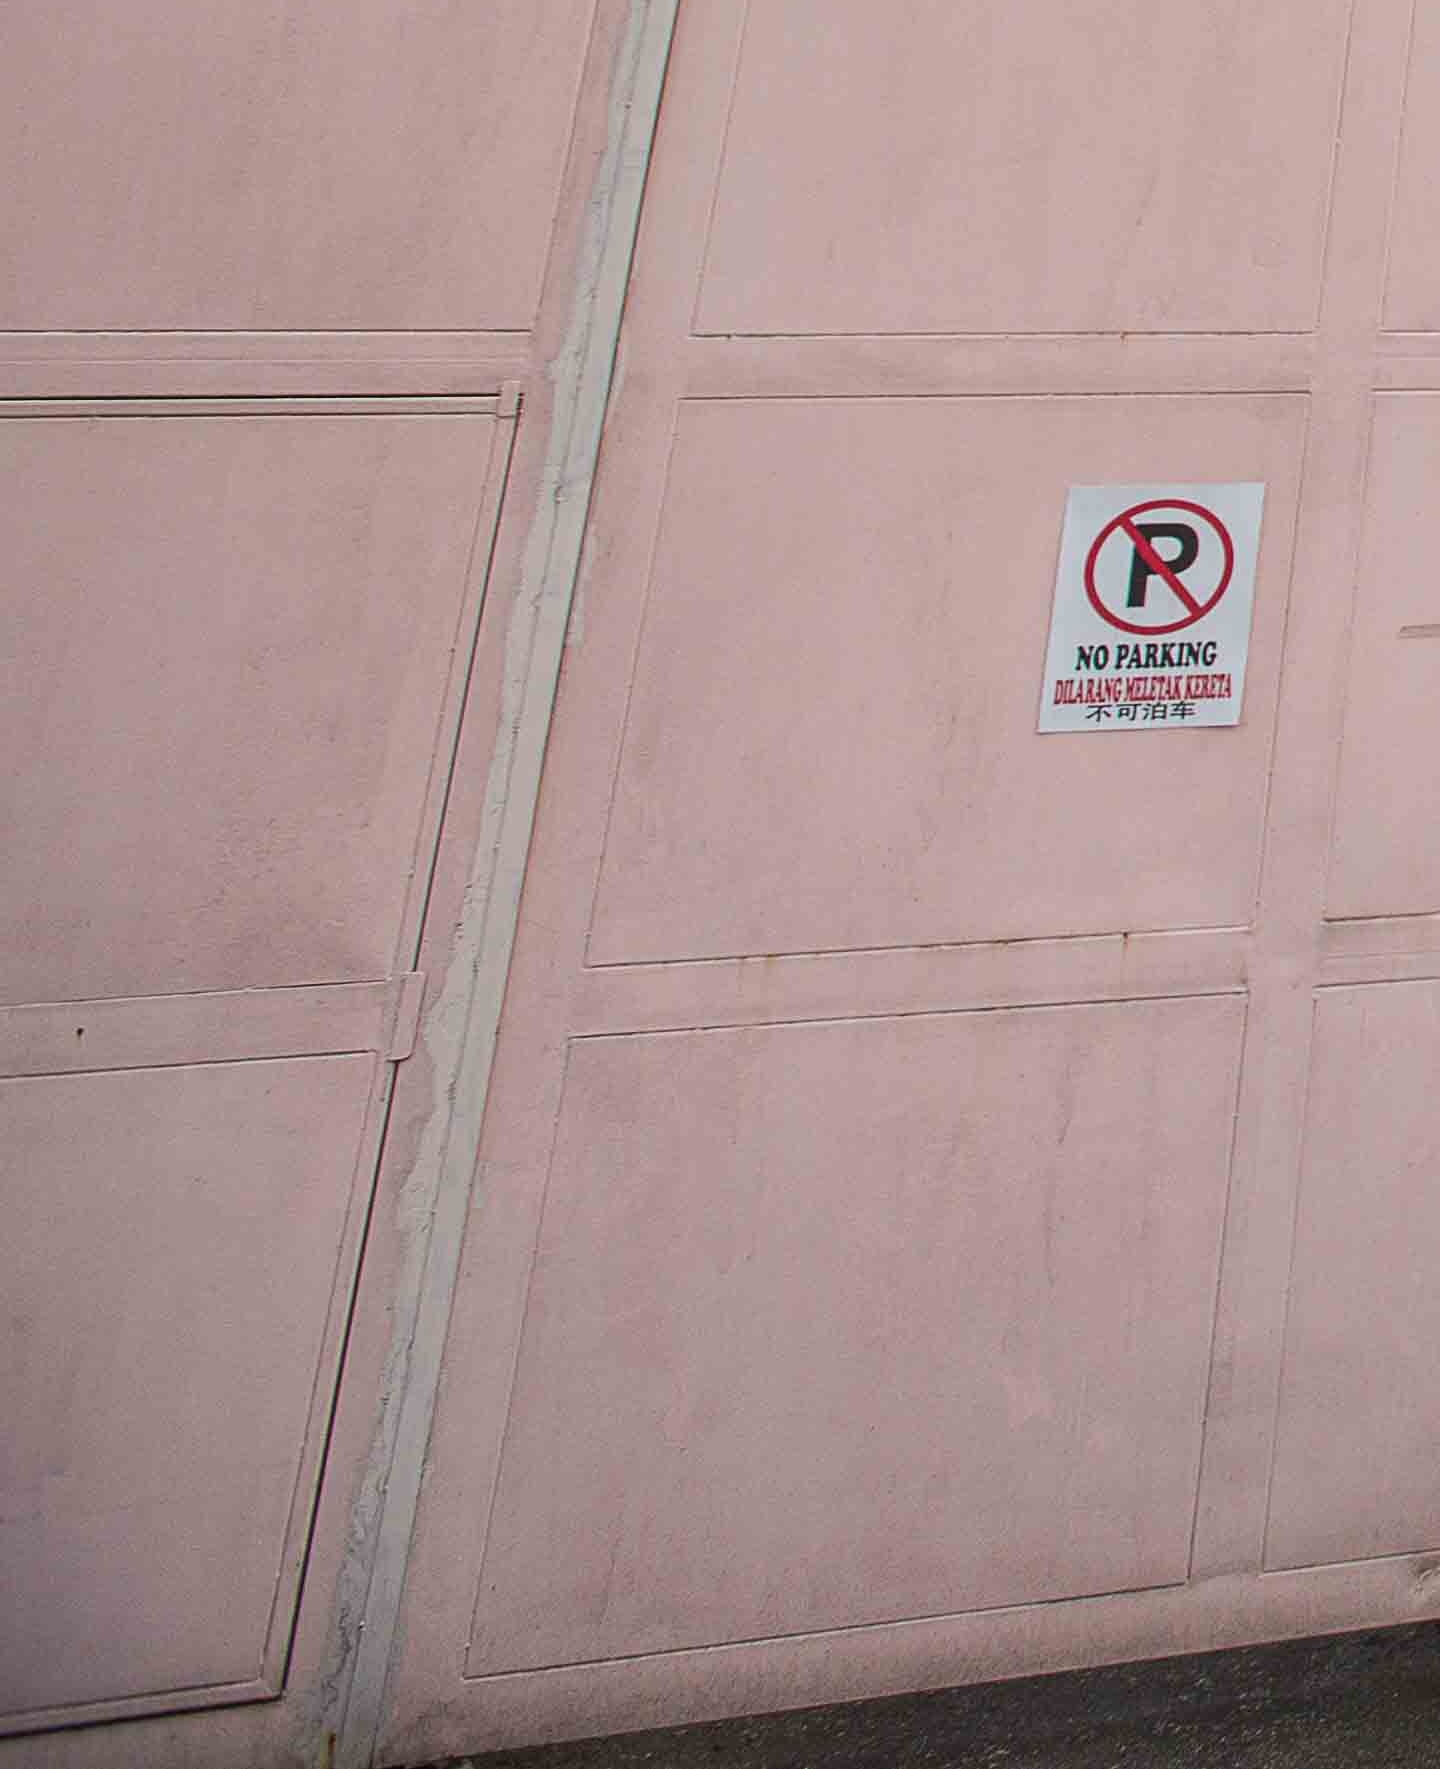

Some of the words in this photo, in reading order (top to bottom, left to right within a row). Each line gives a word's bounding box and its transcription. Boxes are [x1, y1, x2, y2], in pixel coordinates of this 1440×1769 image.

[1075, 645, 1109, 670] NO
[1114, 641, 1217, 670] PARKING
[1054, 677, 1122, 704] DILARANG
[1124, 675, 1183, 702] MELETAK
[1184, 674, 1232, 699] KERETA
[1085, 701, 1196, 722] 不可泊车
